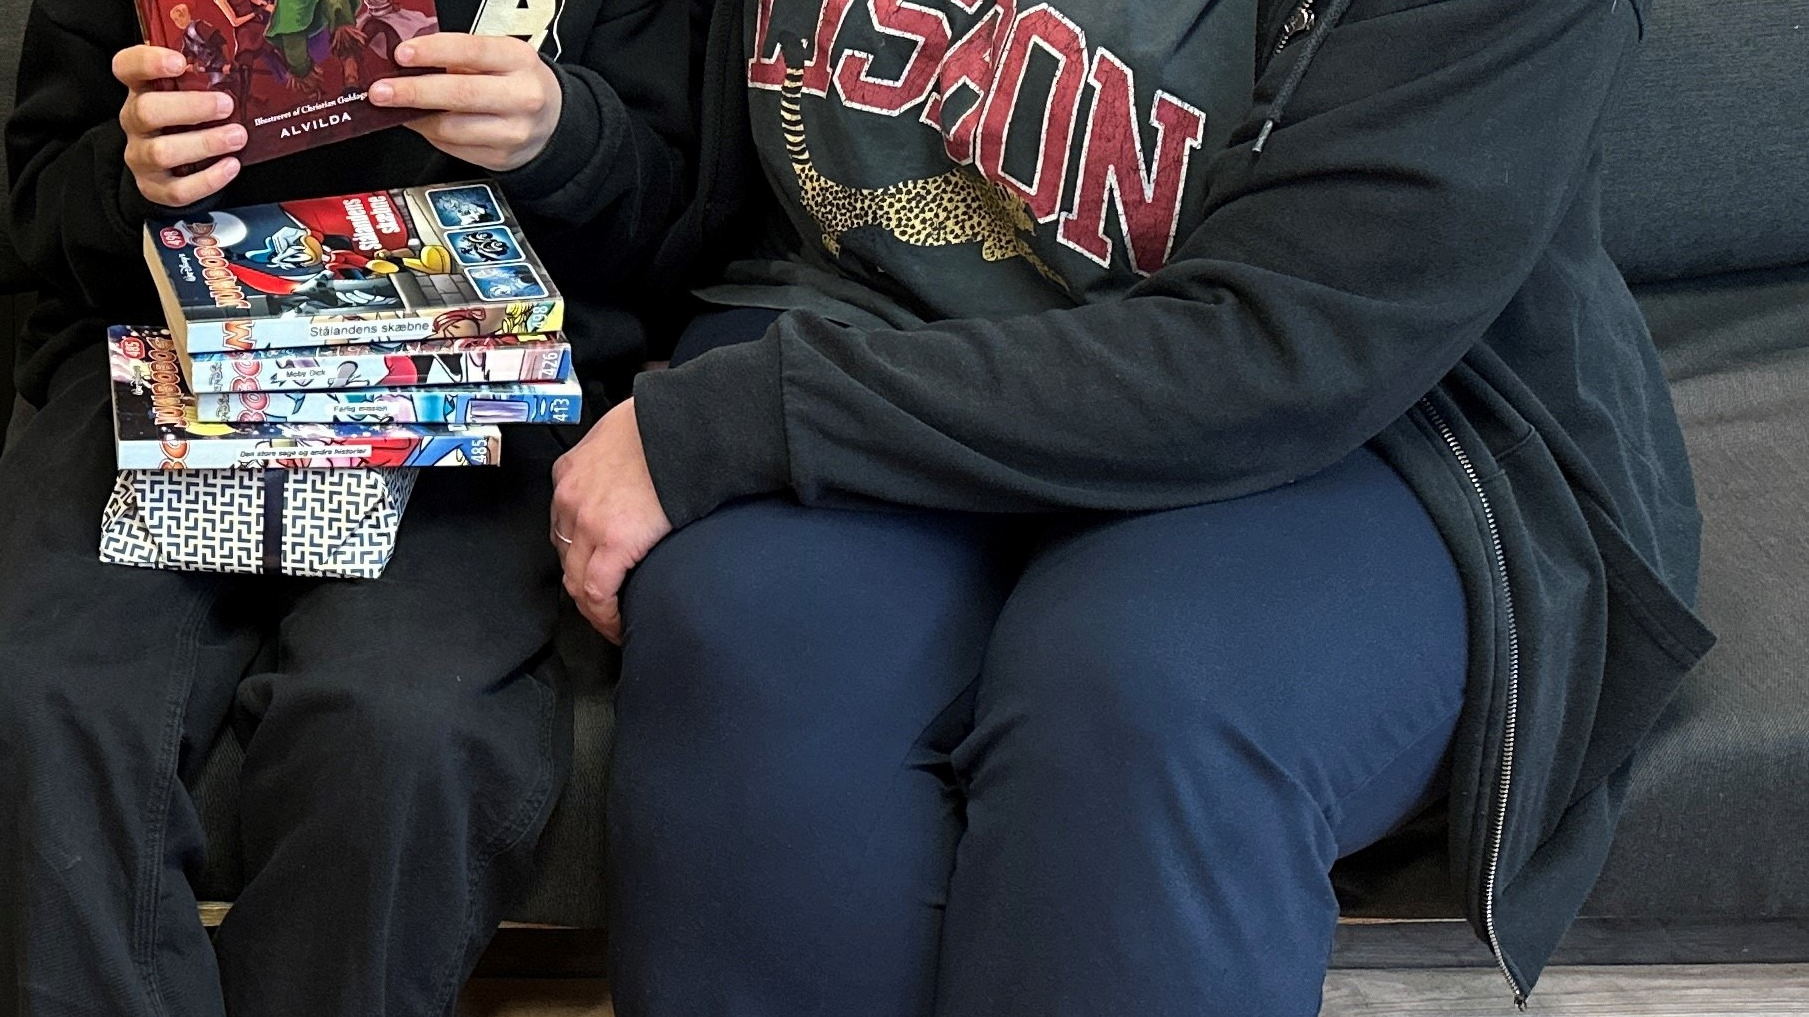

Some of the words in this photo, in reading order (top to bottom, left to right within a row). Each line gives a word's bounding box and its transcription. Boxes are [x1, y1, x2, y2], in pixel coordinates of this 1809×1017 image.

[280, 111, 352, 139] ALVILDA
[310, 324, 379, 338] Stålandens
[381, 321, 431, 334] skæbne
[532, 304, 549, 330] 498
[542, 351, 559, 380] 426
[552, 397, 570, 423] 413
[239, 450, 255, 458] Den
[471, 438, 488, 465] 485
